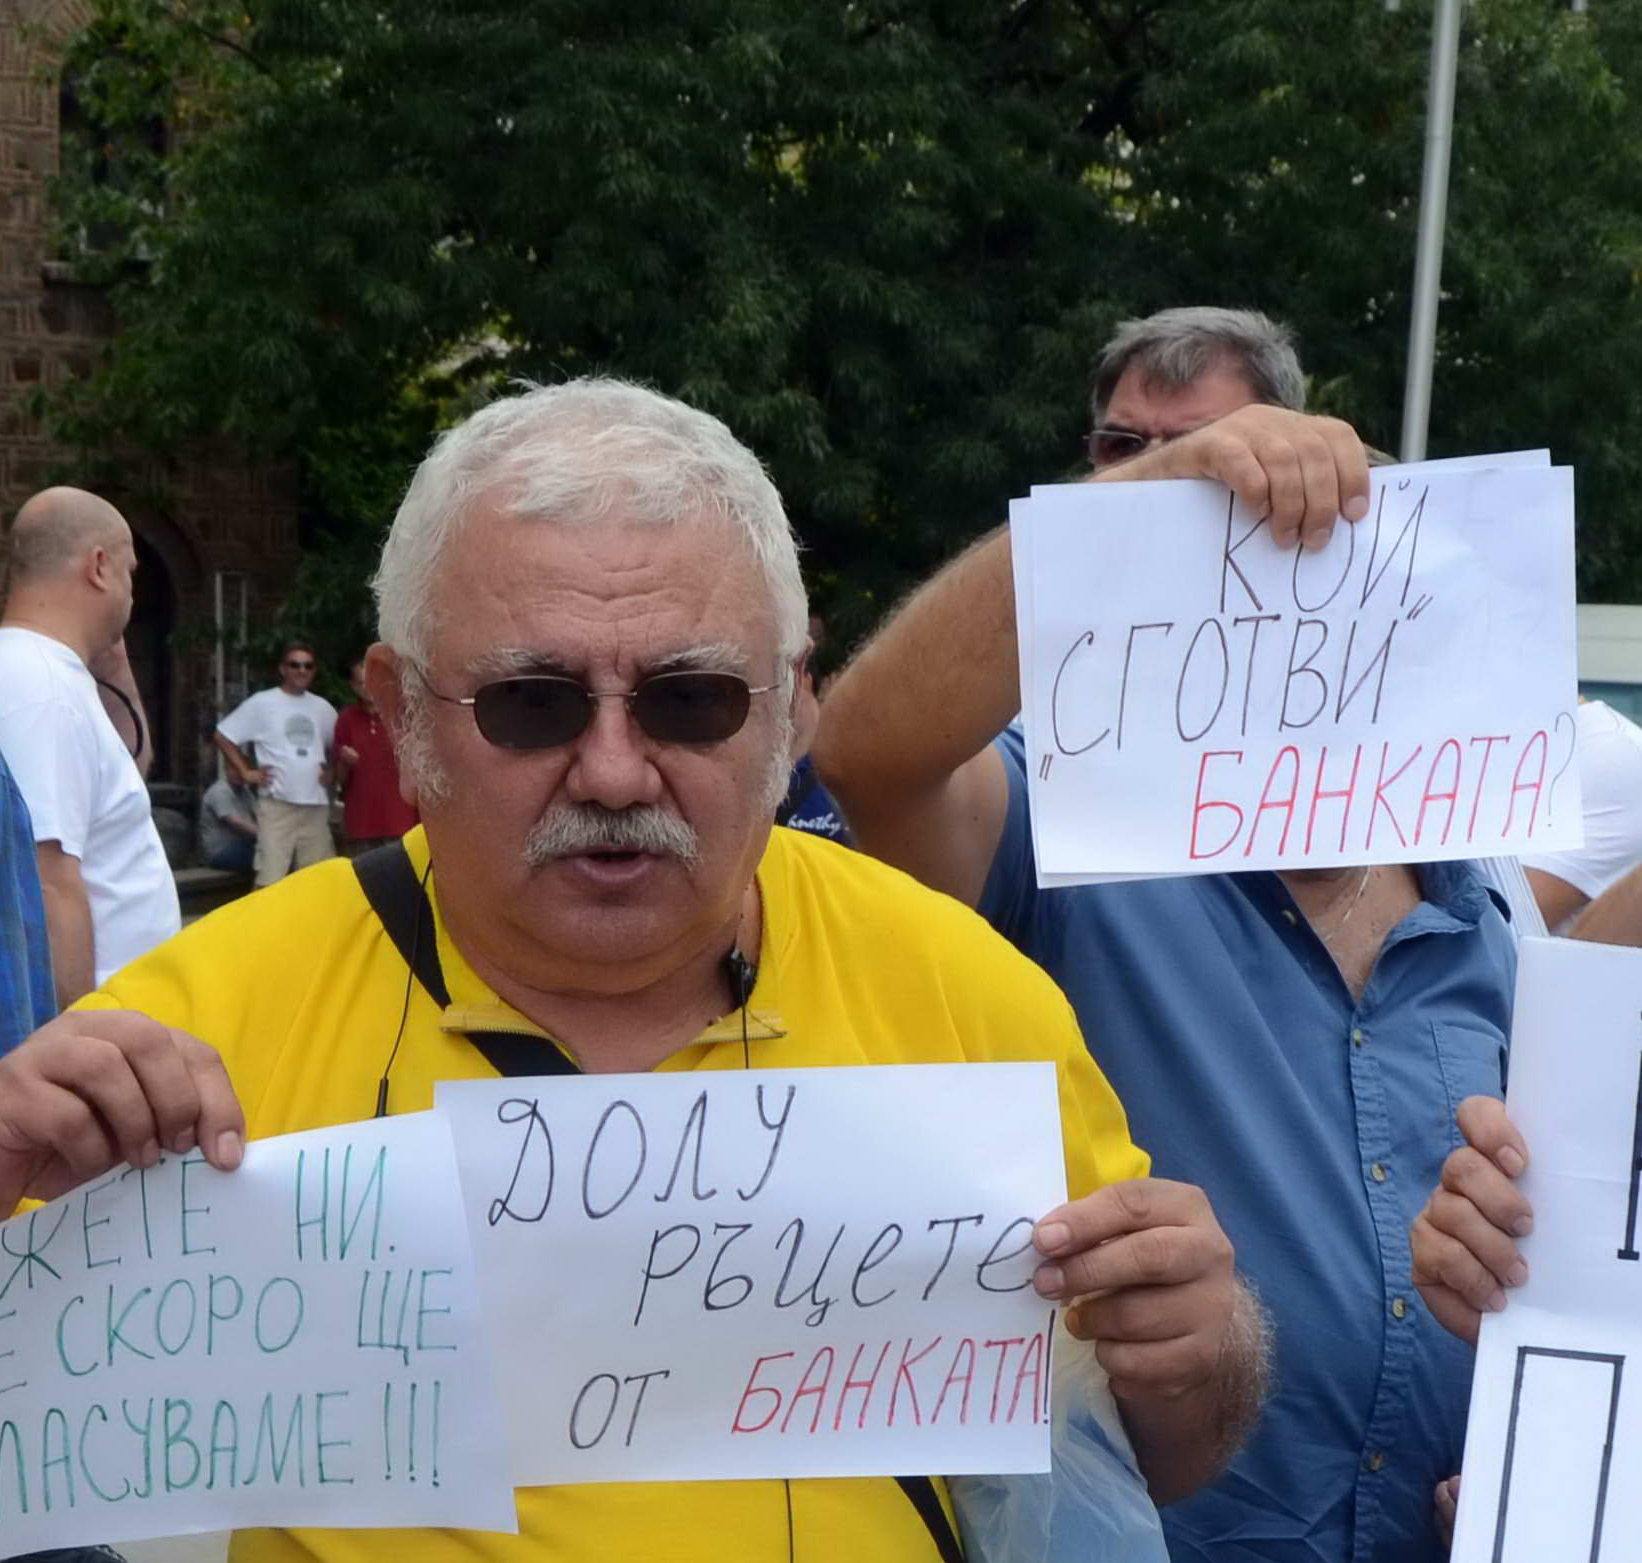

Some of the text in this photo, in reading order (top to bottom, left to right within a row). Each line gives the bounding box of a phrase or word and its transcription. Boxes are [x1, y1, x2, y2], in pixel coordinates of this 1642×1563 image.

[1221, 479, 1428, 613] КОЙ
[1189, 712, 1576, 860] БАНКАТА?
[297, 1145, 396, 1261] НИ.
[488, 1083, 796, 1226] ДОЛУ
[57, 1273, 304, 1376] СКОРО
[357, 1269, 458, 1367] ЩЕ
[569, 1308, 1056, 1450] ОТ БАНКАТА!
